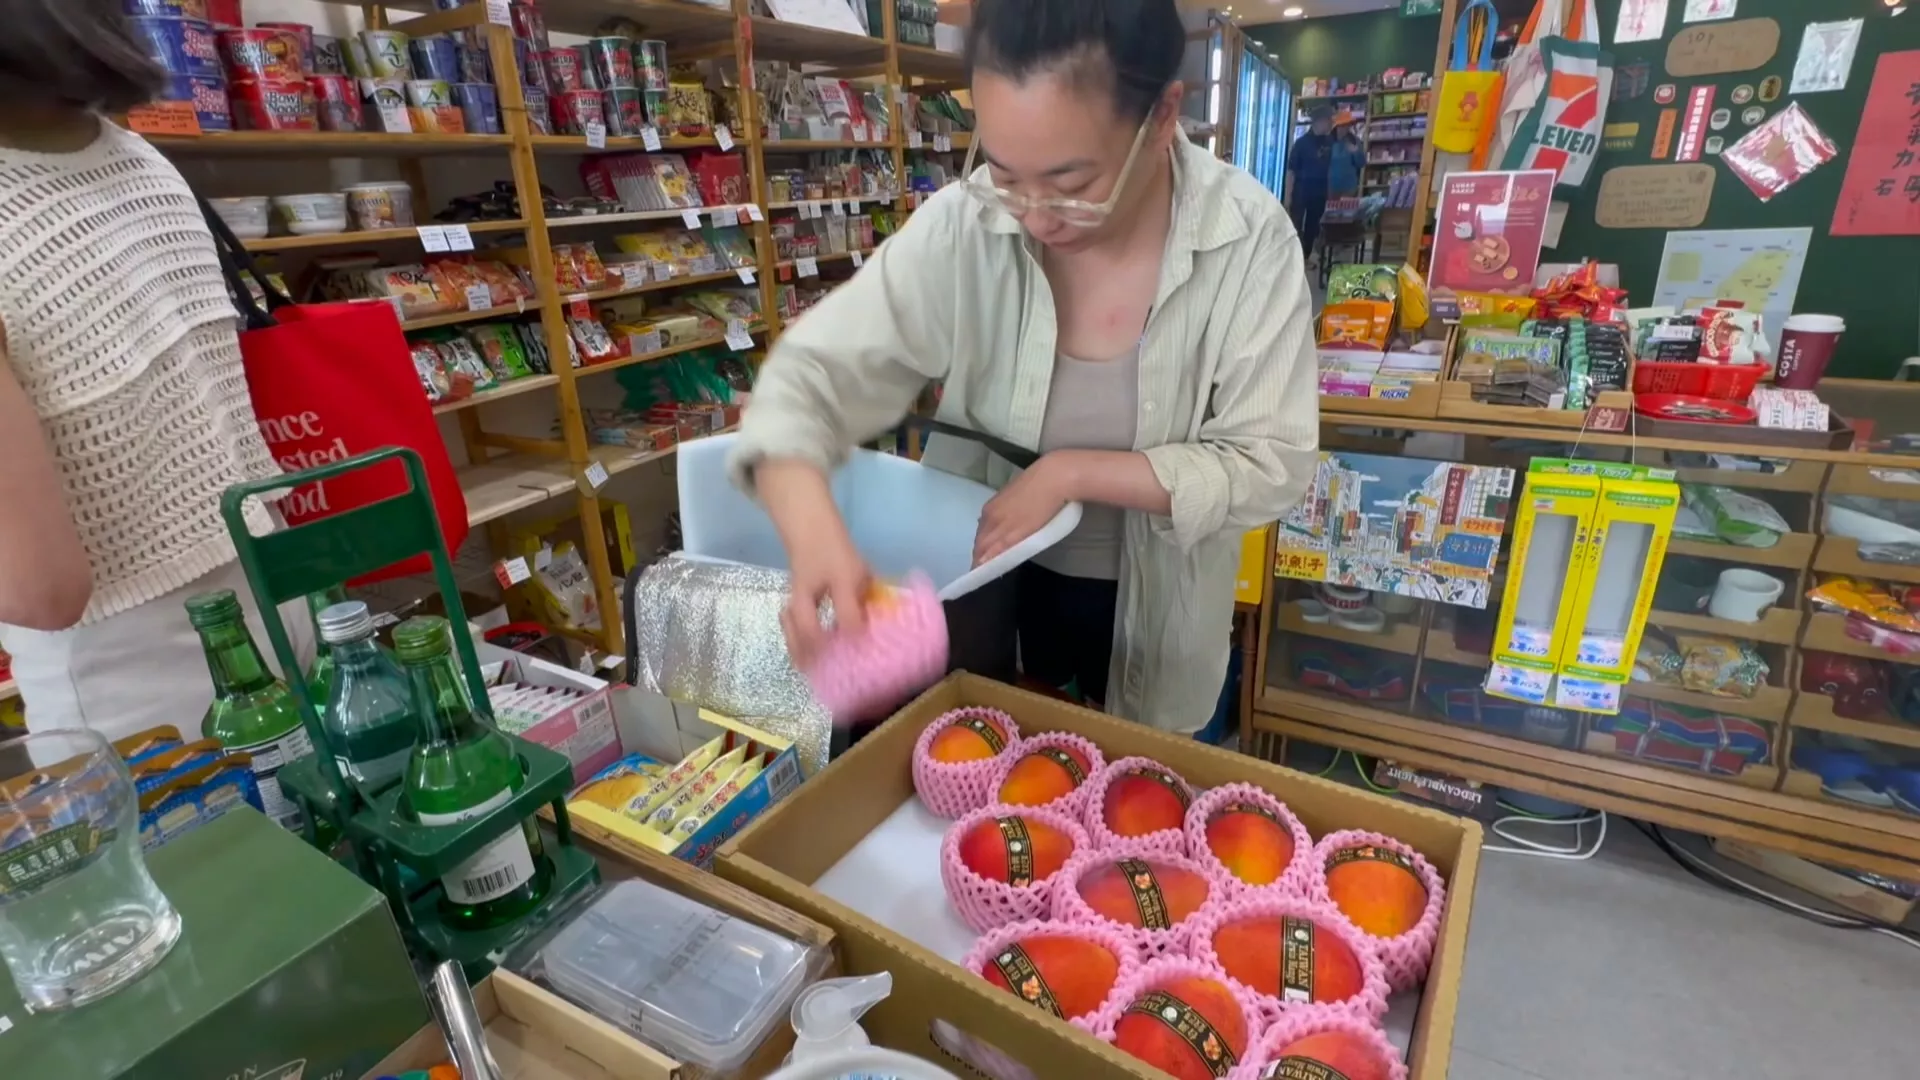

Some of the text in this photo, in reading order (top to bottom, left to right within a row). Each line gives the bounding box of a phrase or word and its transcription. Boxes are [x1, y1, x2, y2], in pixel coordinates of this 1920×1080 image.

[1779, 339, 1797, 378] COSTA
[1139, 891, 1157, 930] AIWAN
[1298, 944, 1309, 987] TAIWAN
